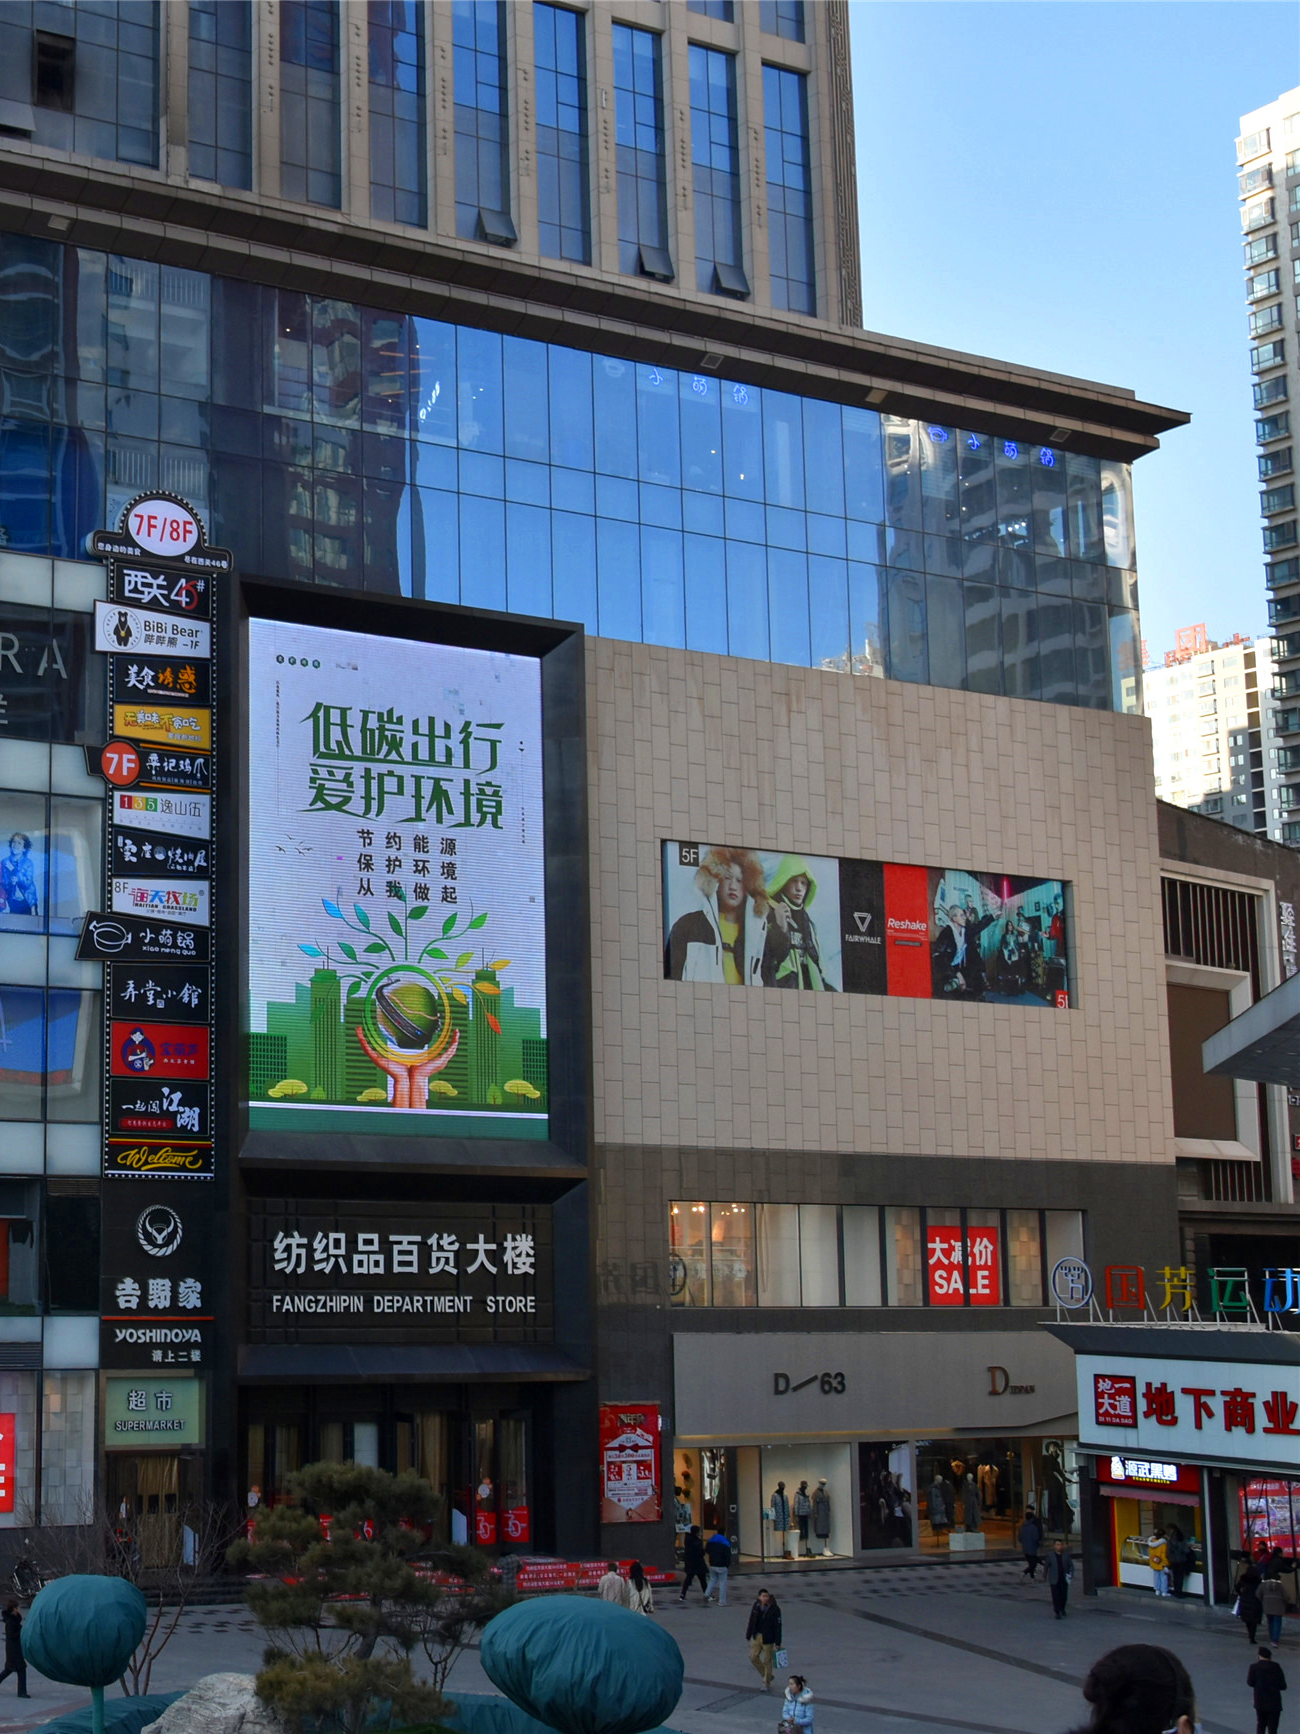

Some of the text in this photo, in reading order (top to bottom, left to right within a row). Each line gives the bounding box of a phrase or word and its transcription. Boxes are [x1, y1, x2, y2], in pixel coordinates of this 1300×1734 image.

[134, 513, 194, 543] 7F/8F
[143, 620, 200, 638] BiBi Bear
[300, 701, 505, 776] 低碳出行
[106, 752, 136, 776] 7F
[297, 762, 504, 830] 爱护环境
[357, 828, 458, 857] 节约能源
[357, 852, 458, 881] 保护环境
[681, 847, 698, 863] 5F
[114, 881, 129, 894] 8F
[128, 887, 199, 907] 海天牧场
[357, 877, 458, 905] 从我做起
[887, 918, 927, 931] Reshake
[139, 927, 195, 949] 小萌锅
[845, 934, 882, 945] FAIRWHALE
[117, 1146, 203, 1171] Welcome
[273, 1230, 537, 1276] 纺织品百货大楼
[927, 1236, 994, 1266] 大减价
[115, 1277, 202, 1310] 吉野家
[272, 1294, 536, 1313] FANGZHIPIN DEPARTMENT STORE
[115, 1328, 202, 1343] YOSHINOYA
[128, 1390, 173, 1411] 超市
[1097, 1394, 1132, 1416] 大道
[1142, 1381, 1300, 1435] 地下商业
[115, 1419, 186, 1431] SUPERMARKET
